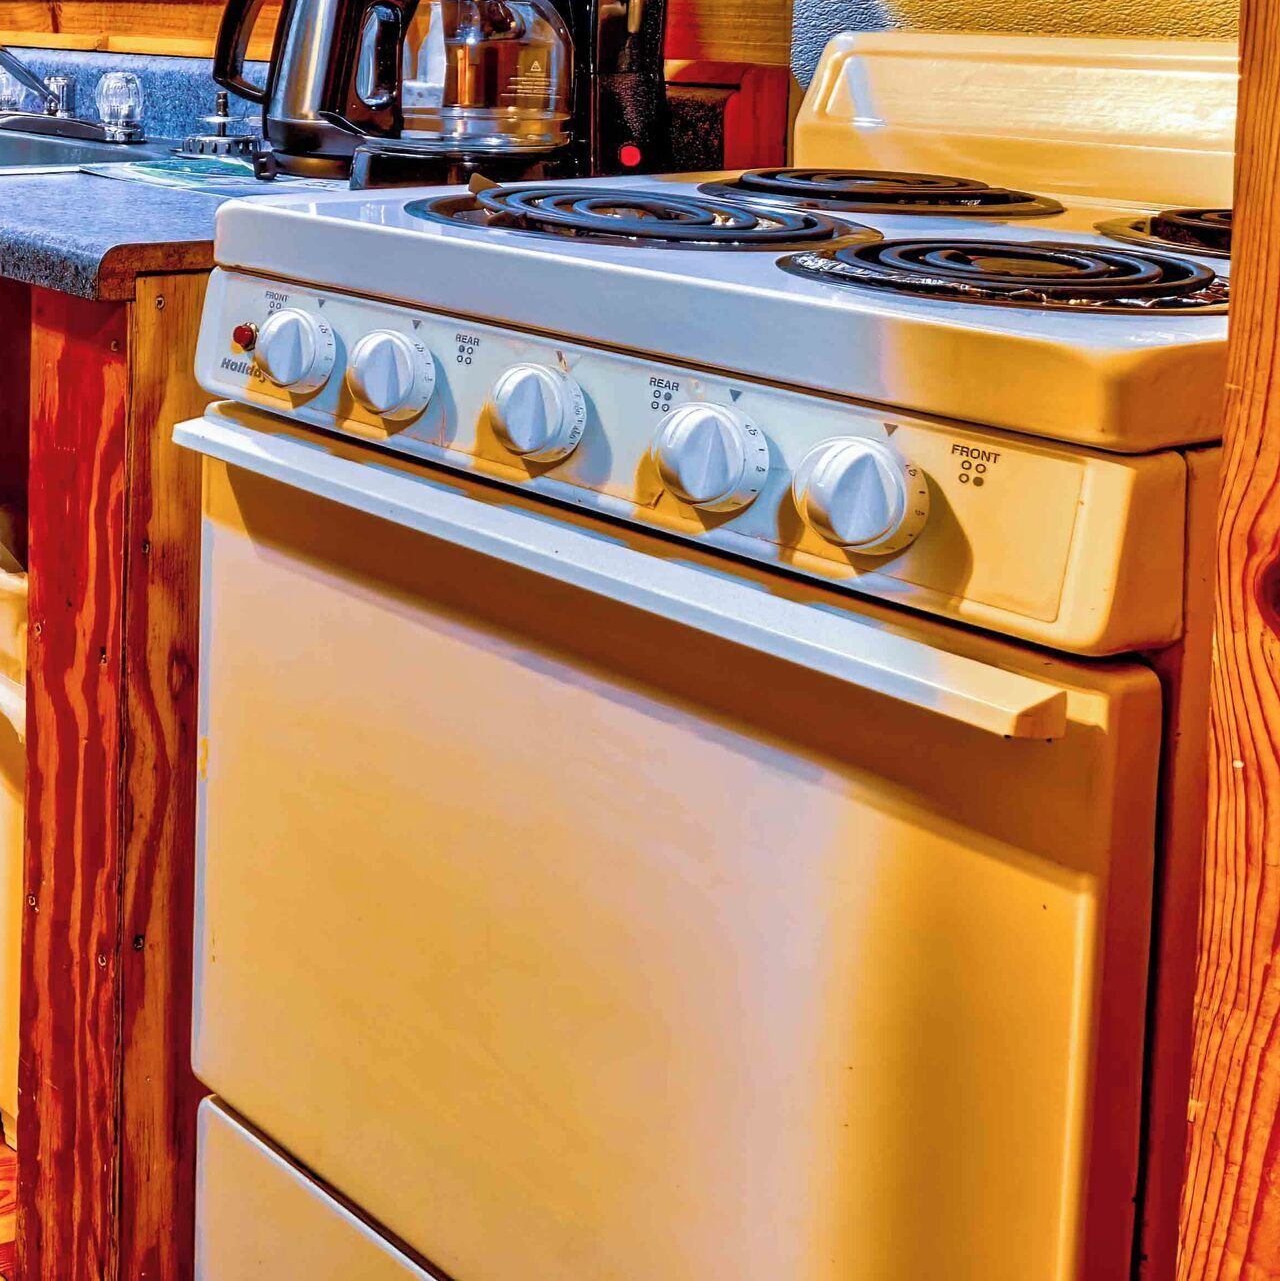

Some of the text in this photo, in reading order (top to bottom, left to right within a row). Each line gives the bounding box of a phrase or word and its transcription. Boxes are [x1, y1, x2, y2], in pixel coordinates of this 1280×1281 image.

[265, 291, 289, 302] FRONT
[455, 333, 480, 347] REAR
[649, 376, 680, 392] REAR
[951, 443, 1001, 464] FRONT
